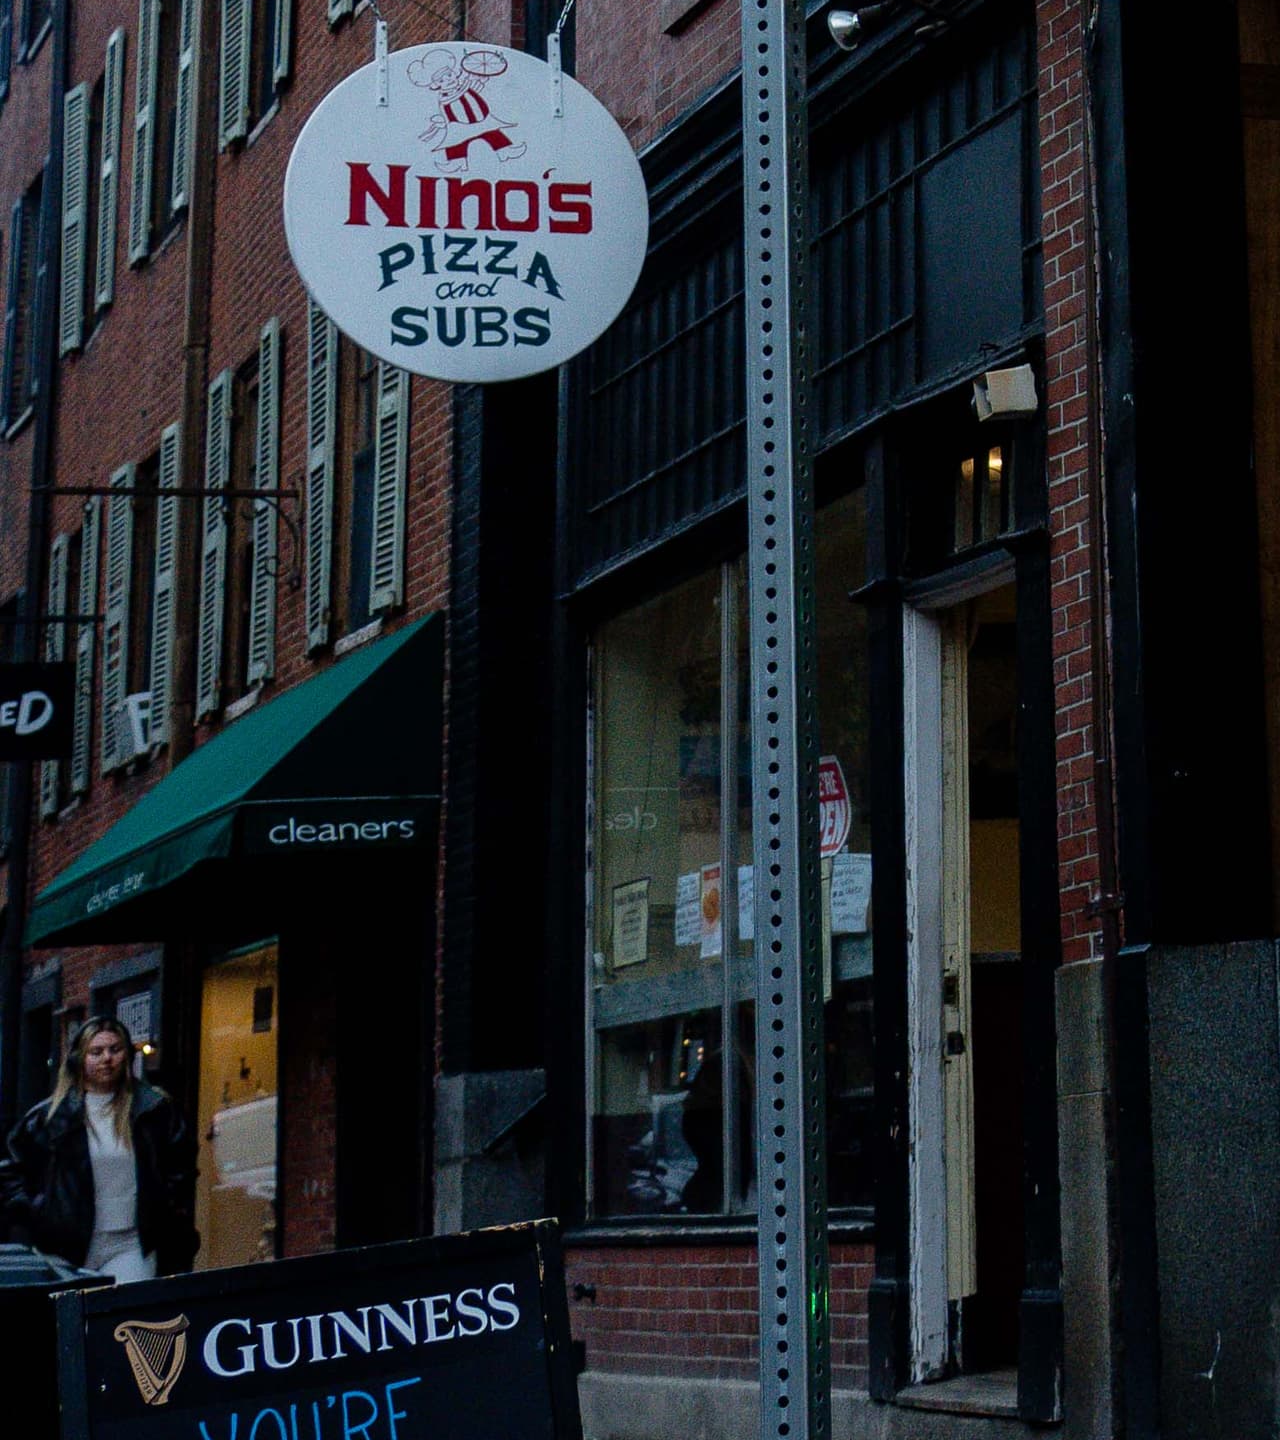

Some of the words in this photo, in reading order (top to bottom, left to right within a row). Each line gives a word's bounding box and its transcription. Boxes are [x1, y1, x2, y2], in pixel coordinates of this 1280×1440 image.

[377, 234, 566, 301] PIZZA
[435, 276, 500, 300] and
[390, 306, 552, 348] SUBS
[268, 816, 416, 847] cleaners
[203, 1283, 520, 1376] GUINNESS
